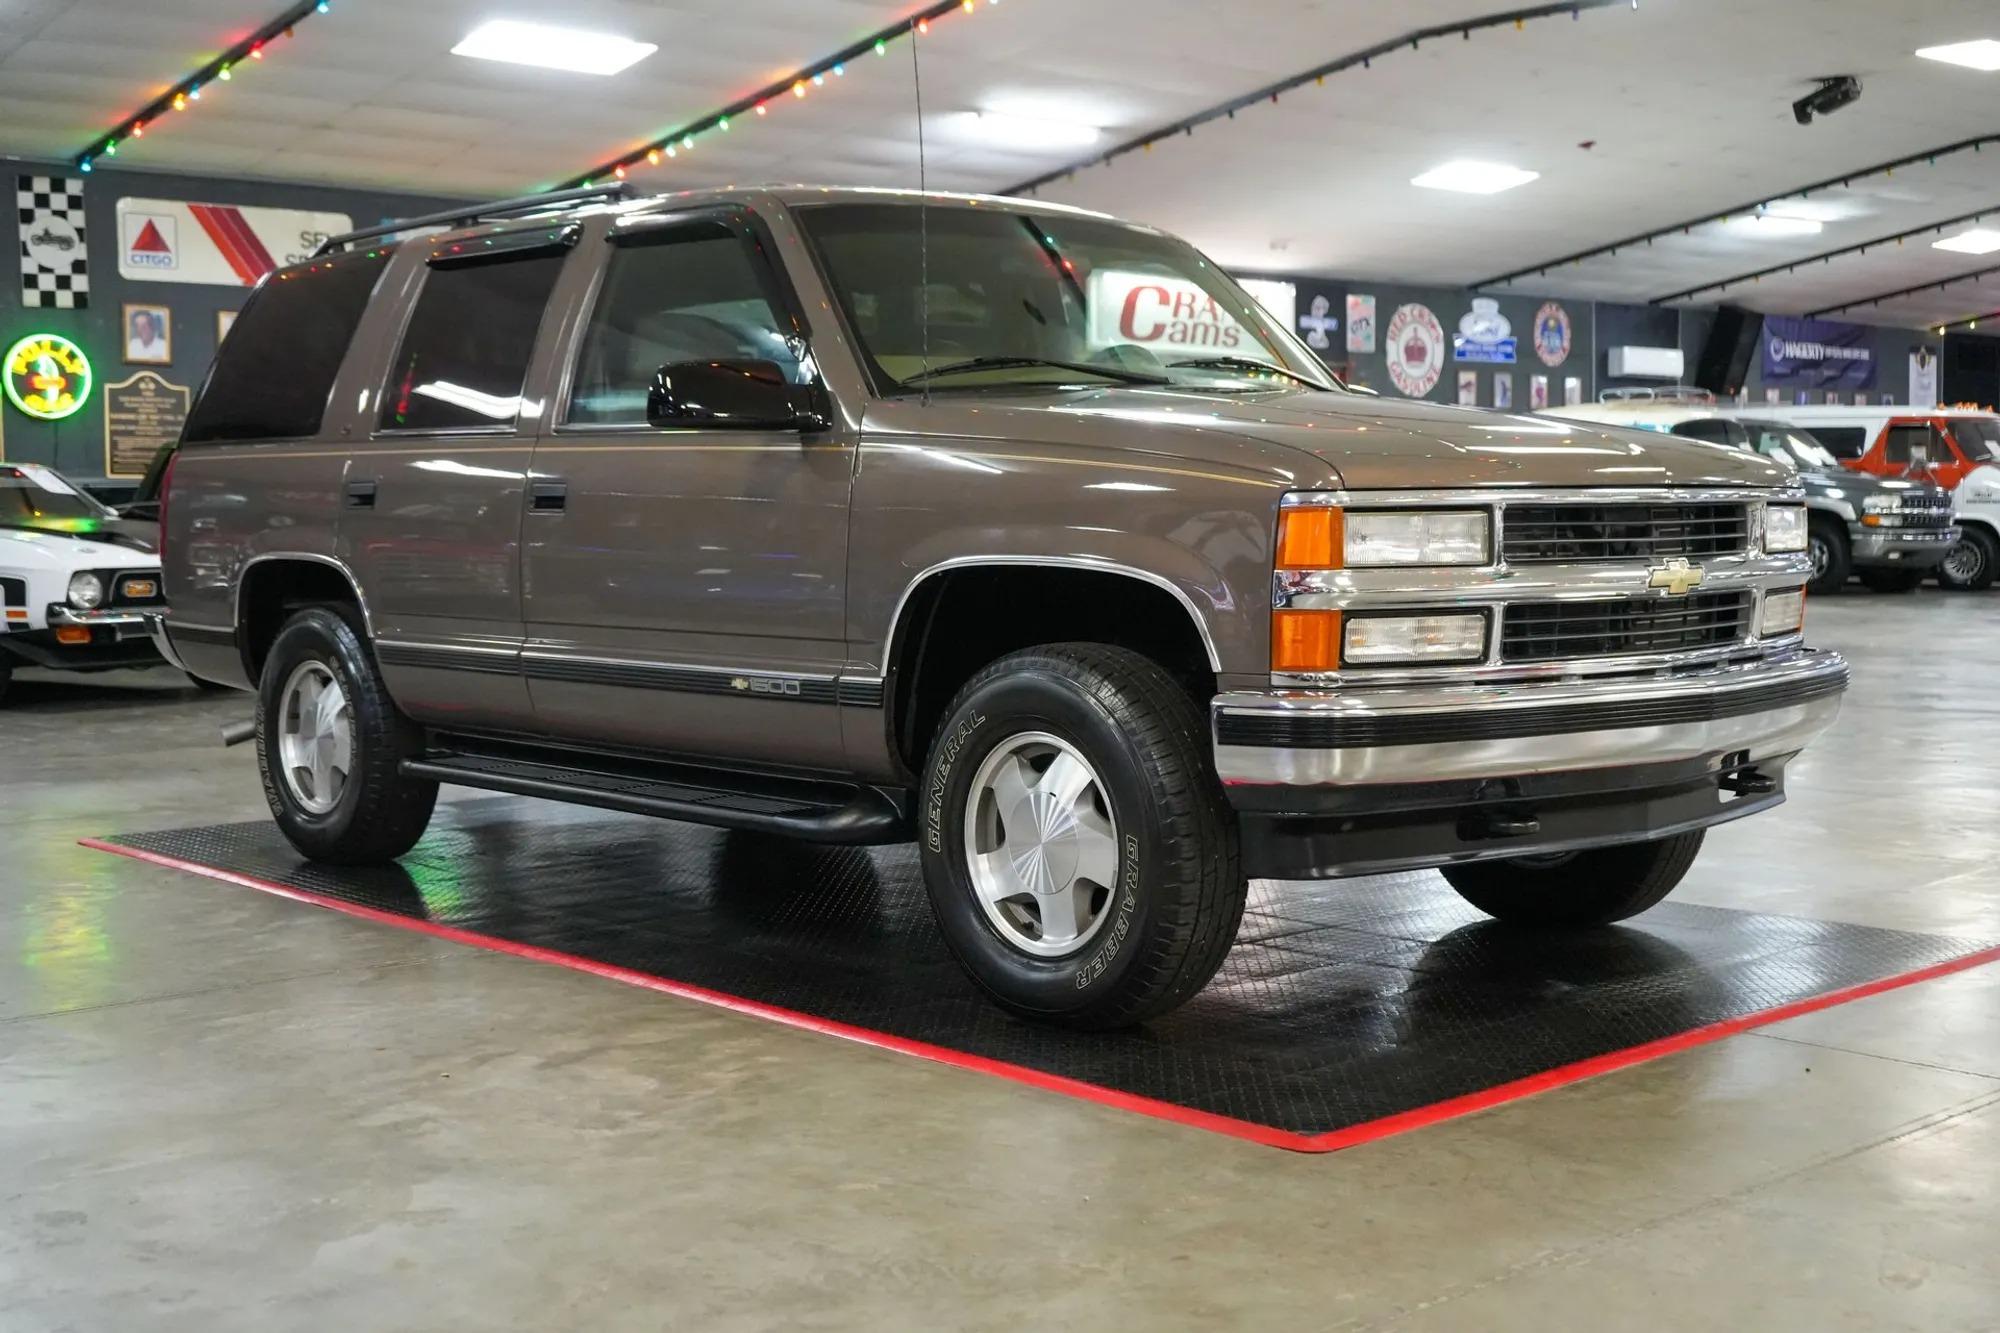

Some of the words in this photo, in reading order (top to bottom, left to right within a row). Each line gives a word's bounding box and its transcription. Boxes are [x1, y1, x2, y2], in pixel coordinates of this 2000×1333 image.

[130, 254, 172, 267] CITGO
[301, 231, 330, 249] SE
[927, 709, 986, 853] GENERAL
[1075, 833, 1140, 990] GRABBER
